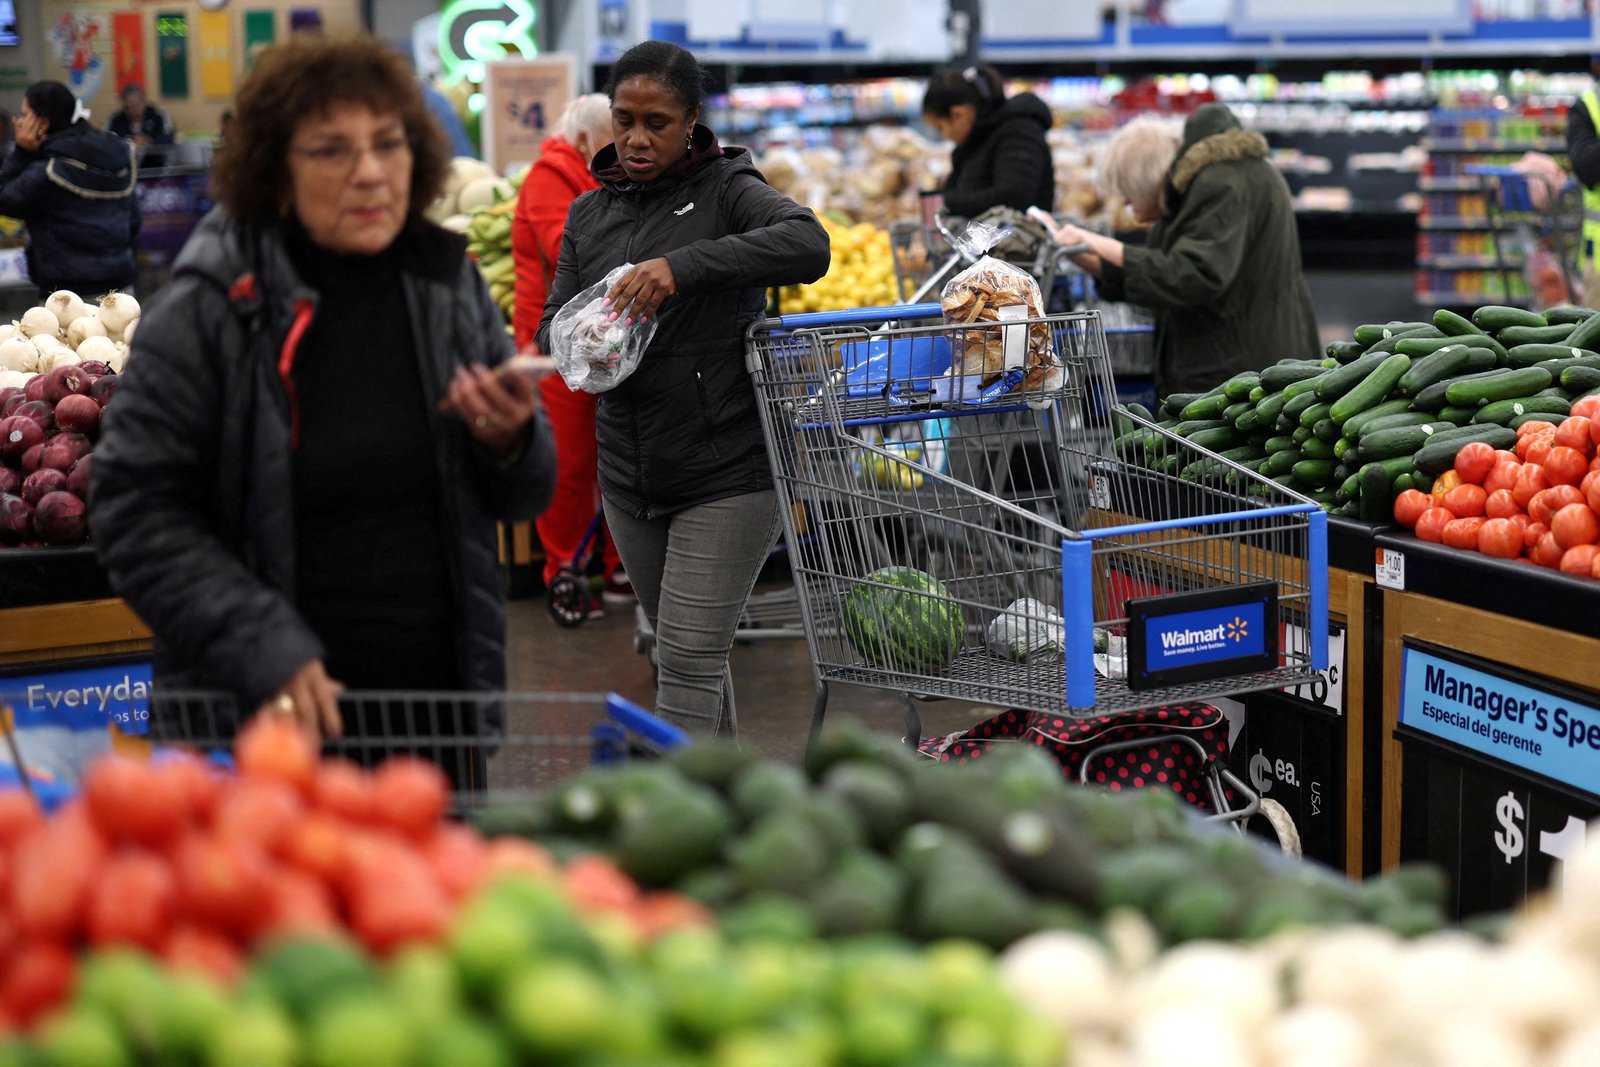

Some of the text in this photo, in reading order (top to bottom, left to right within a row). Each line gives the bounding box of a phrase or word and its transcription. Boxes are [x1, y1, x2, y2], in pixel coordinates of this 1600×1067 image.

[1161, 623, 1226, 649] Walmart
[1163, 648, 1177, 657] Save
[1196, 644, 1208, 652] Live
[1424, 664, 1548, 732] Manager's
[1422, 701, 1542, 756] Especial del gerente
[1274, 758, 1300, 788] ea.
[1310, 781, 1321, 816] USA
